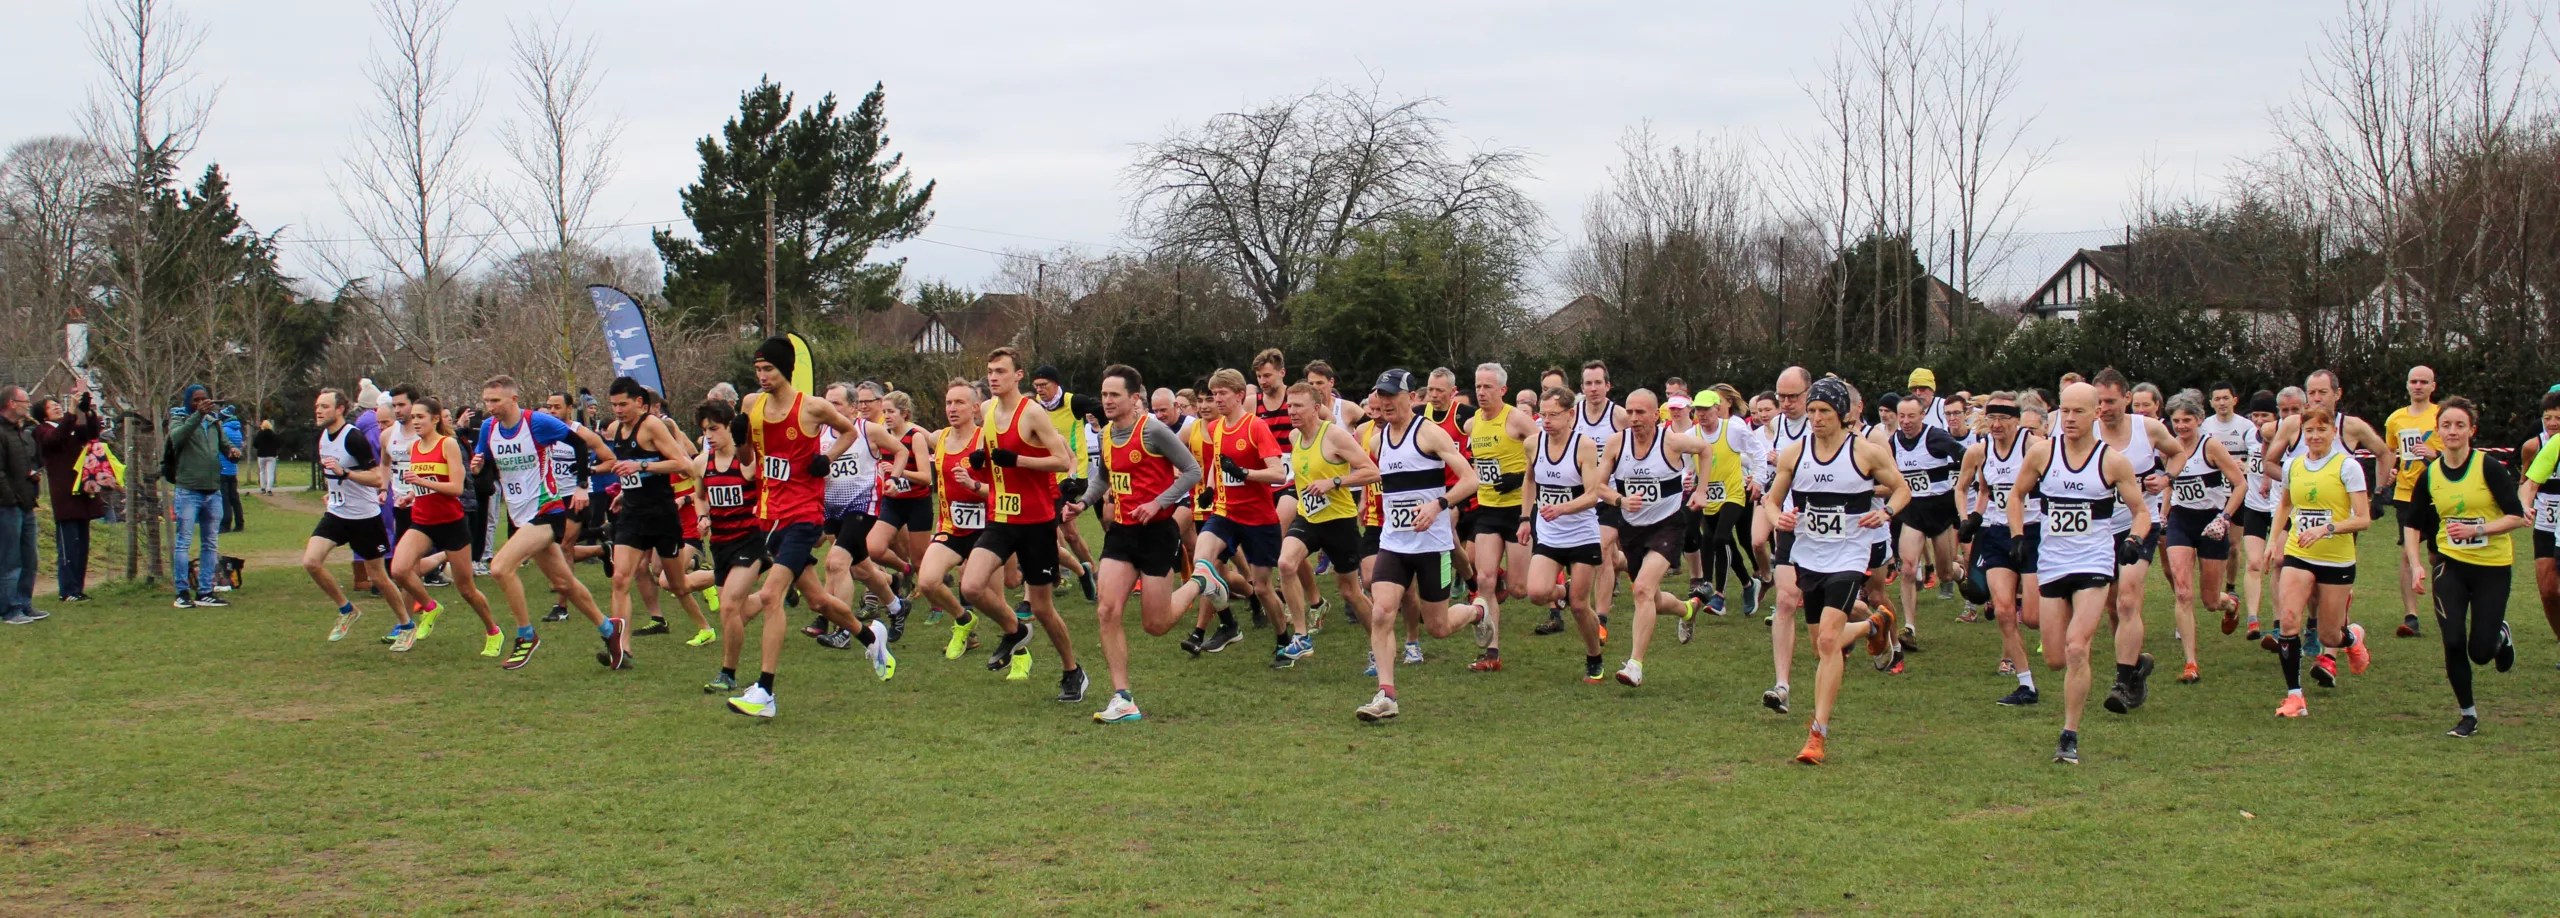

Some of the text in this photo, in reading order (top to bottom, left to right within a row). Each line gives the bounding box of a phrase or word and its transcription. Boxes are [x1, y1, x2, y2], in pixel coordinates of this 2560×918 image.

[497, 443, 522, 455] DAN
[765, 456, 788, 480] 187
[831, 460, 858, 478] 343
[1388, 461, 1403, 470] VAC
[1996, 466, 2011, 475] VAC
[1112, 474, 1129, 491] 174
[1546, 470, 1561, 479] VAC
[1813, 473, 1834, 483] VAC
[507, 482, 522, 495] 86
[2063, 480, 2084, 491] VAC
[2175, 483, 2205, 501] 308
[709, 486, 741, 506] 1048
[999, 495, 1019, 512] 178
[1302, 494, 1326, 513] 324
[954, 508, 981, 526] 371
[1807, 511, 1842, 535] 354
[2050, 510, 2088, 533] 326
